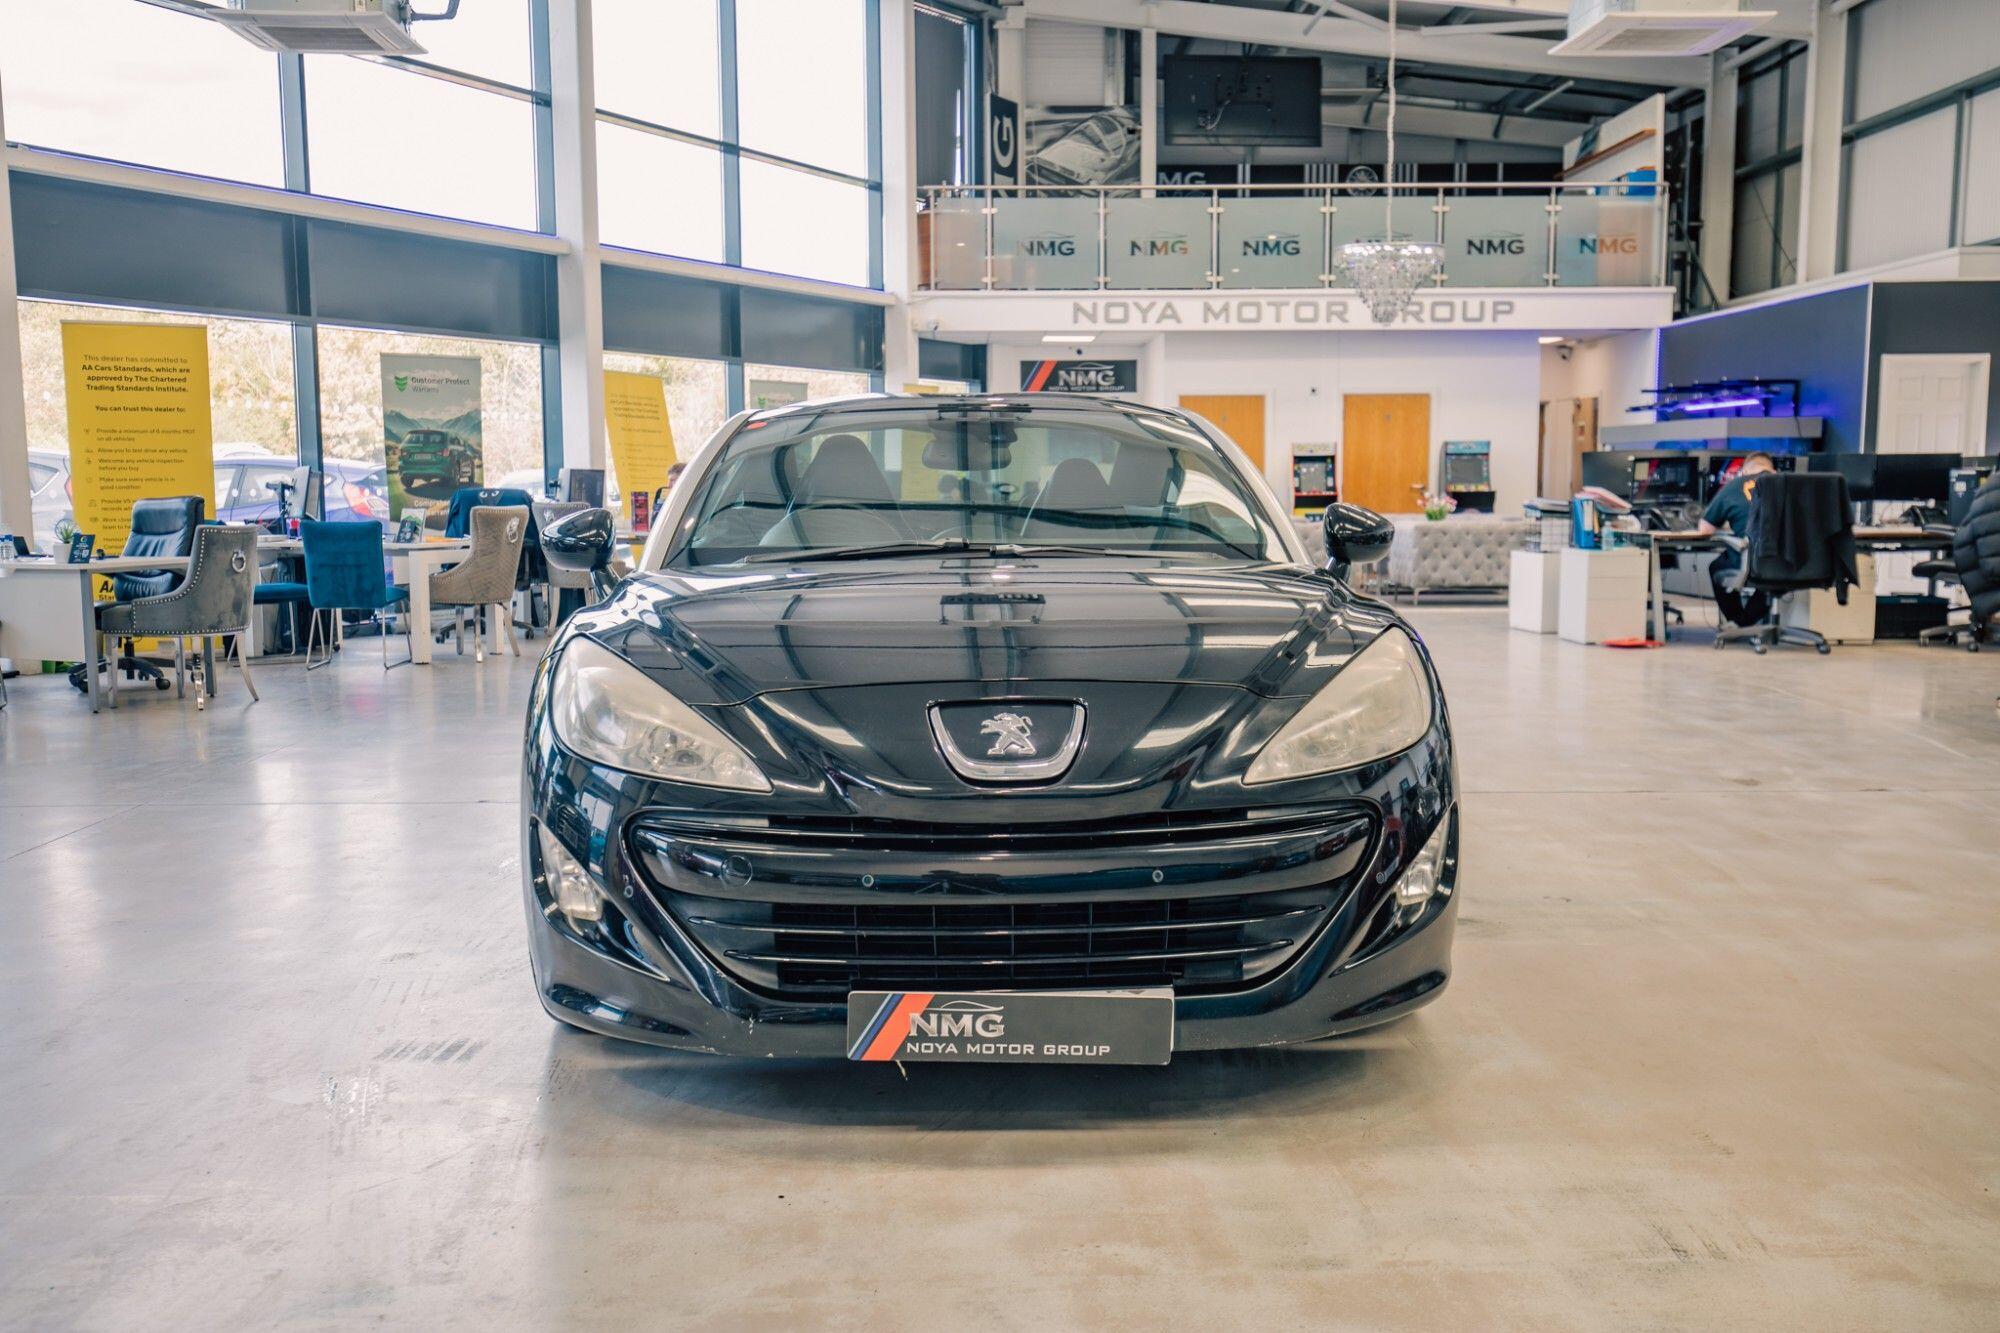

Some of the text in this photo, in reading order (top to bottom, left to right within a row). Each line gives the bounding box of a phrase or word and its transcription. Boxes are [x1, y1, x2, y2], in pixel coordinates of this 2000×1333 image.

[1016, 240, 1075, 256] NMG
[1130, 240, 1188, 256] NMG
[1242, 240, 1300, 256] NMG
[1467, 239, 1525, 255] NMG
[1579, 238, 1638, 254] NMG
[1072, 302, 1182, 324] NOYA
[1204, 302, 1349, 324] MOTOR
[1058, 370, 1115, 386] NMG
[908, 1012, 1005, 1038] NMG
[907, 1042, 1111, 1056] NOYA MOTOR GROUP
